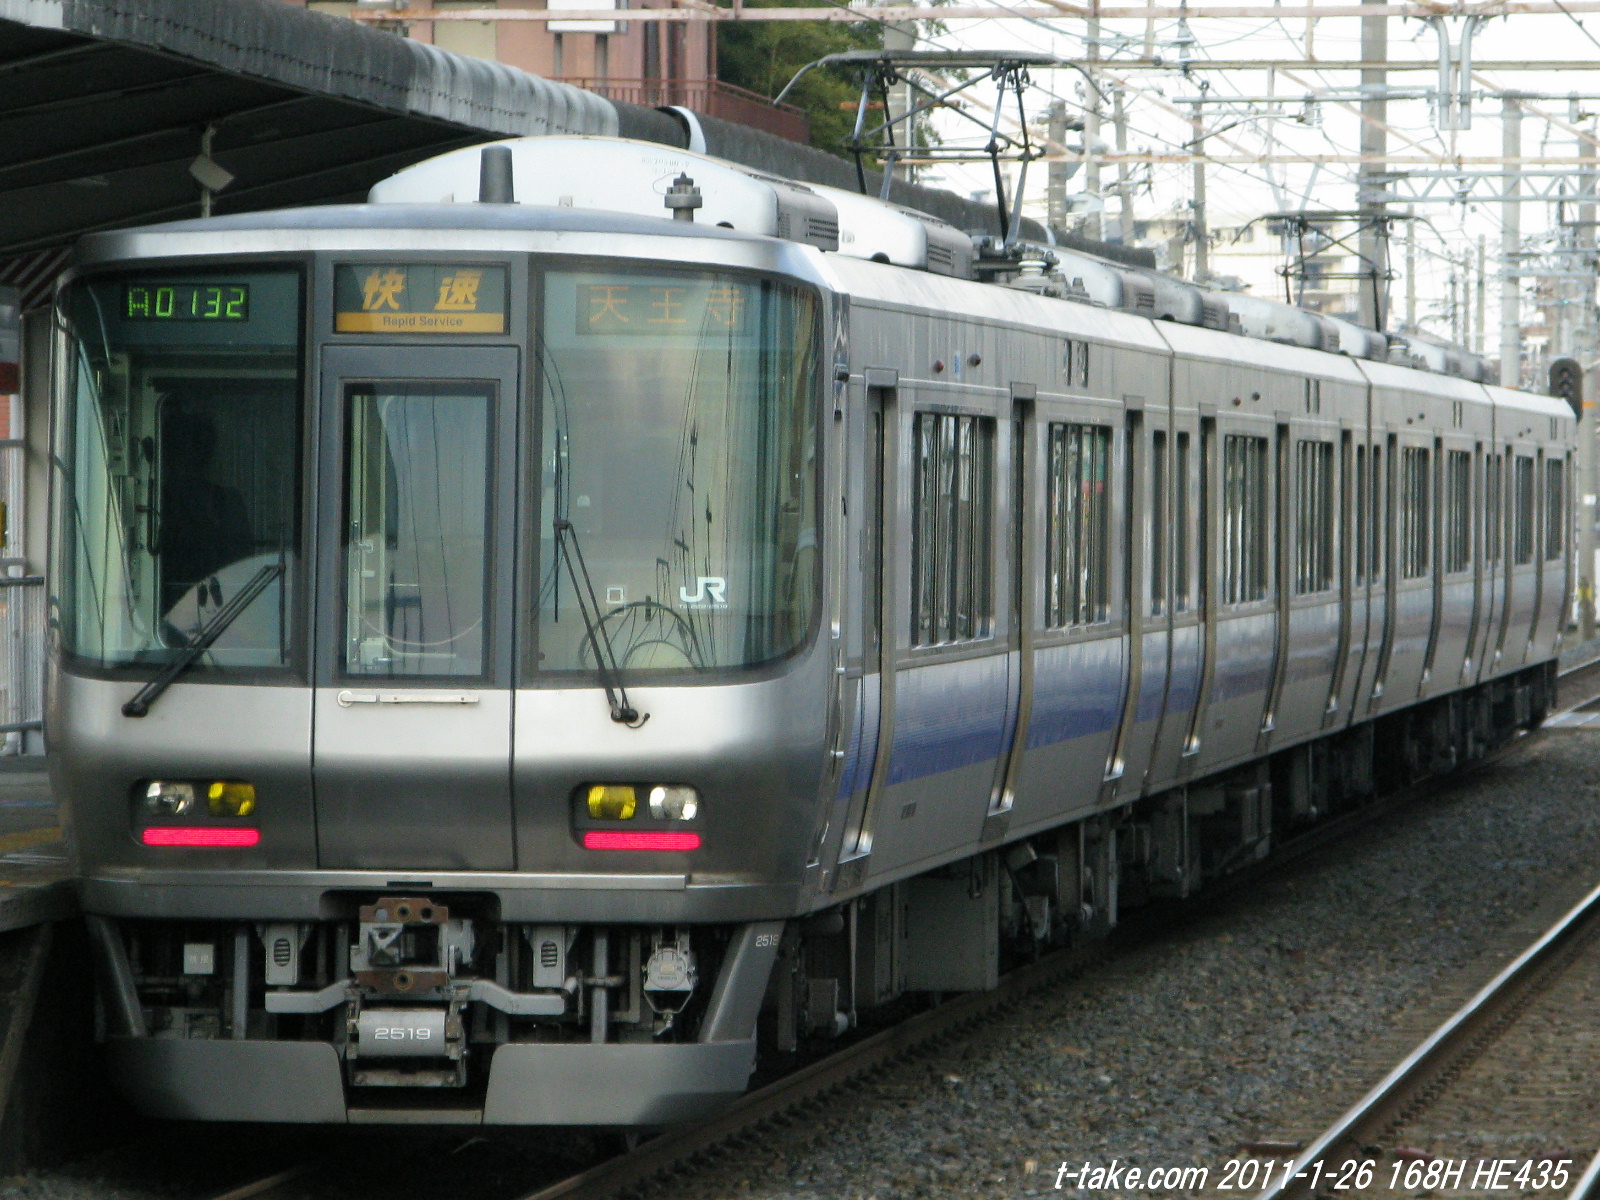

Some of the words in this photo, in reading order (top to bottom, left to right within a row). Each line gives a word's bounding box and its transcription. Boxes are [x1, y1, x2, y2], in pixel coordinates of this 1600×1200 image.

[128, 287, 245, 318] A0132
[361, 268, 483, 311] 快速
[589, 285, 745, 325] 天王寺
[382, 315, 415, 328] Rapid
[419, 315, 463, 327] Service
[680, 576, 727, 603] JR
[374, 1027, 431, 1040] 2519
